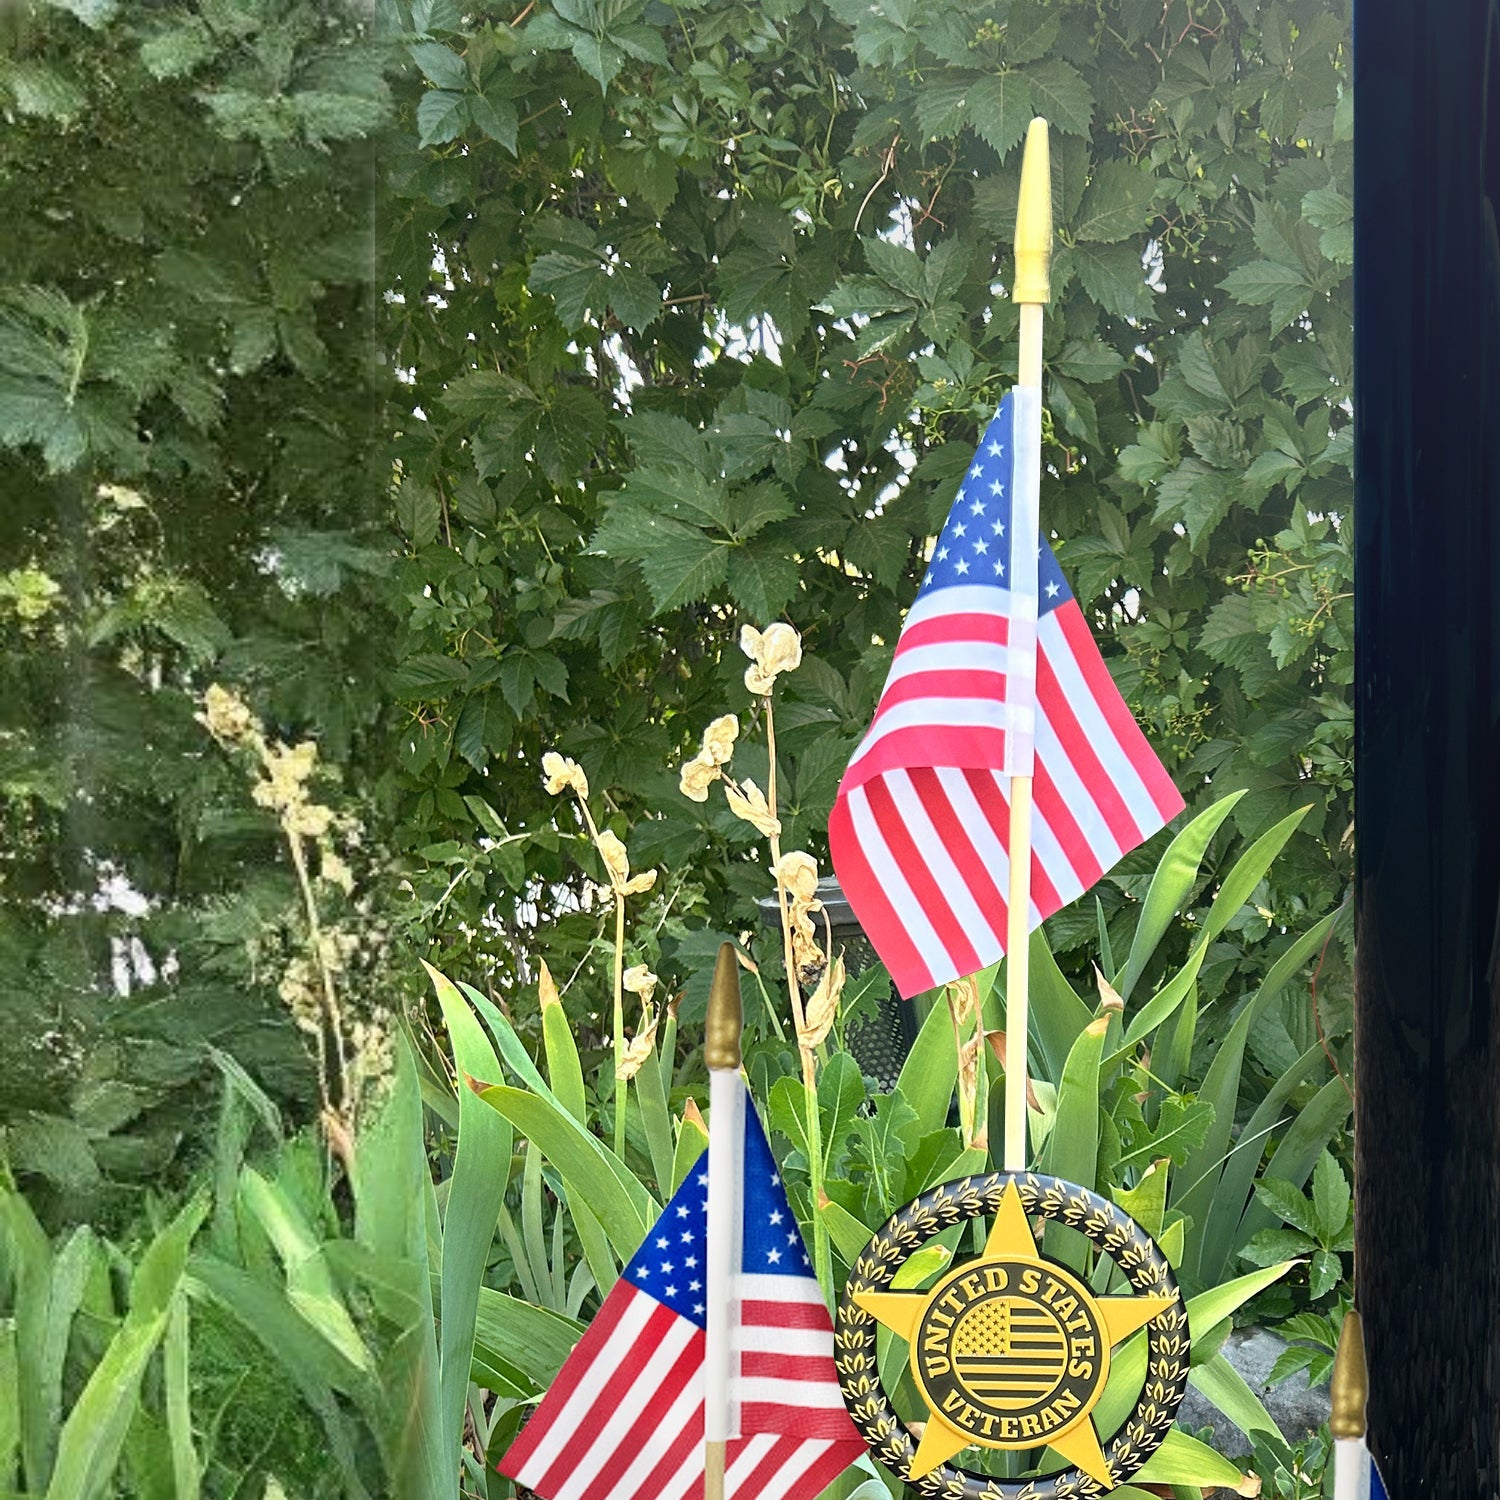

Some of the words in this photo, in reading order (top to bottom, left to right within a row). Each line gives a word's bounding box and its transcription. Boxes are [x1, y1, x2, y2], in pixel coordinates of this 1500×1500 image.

[924, 1267, 1009, 1379] UNITED
[1019, 1268, 1095, 1380] STATES
[942, 1388, 1082, 1439] VETERAN
